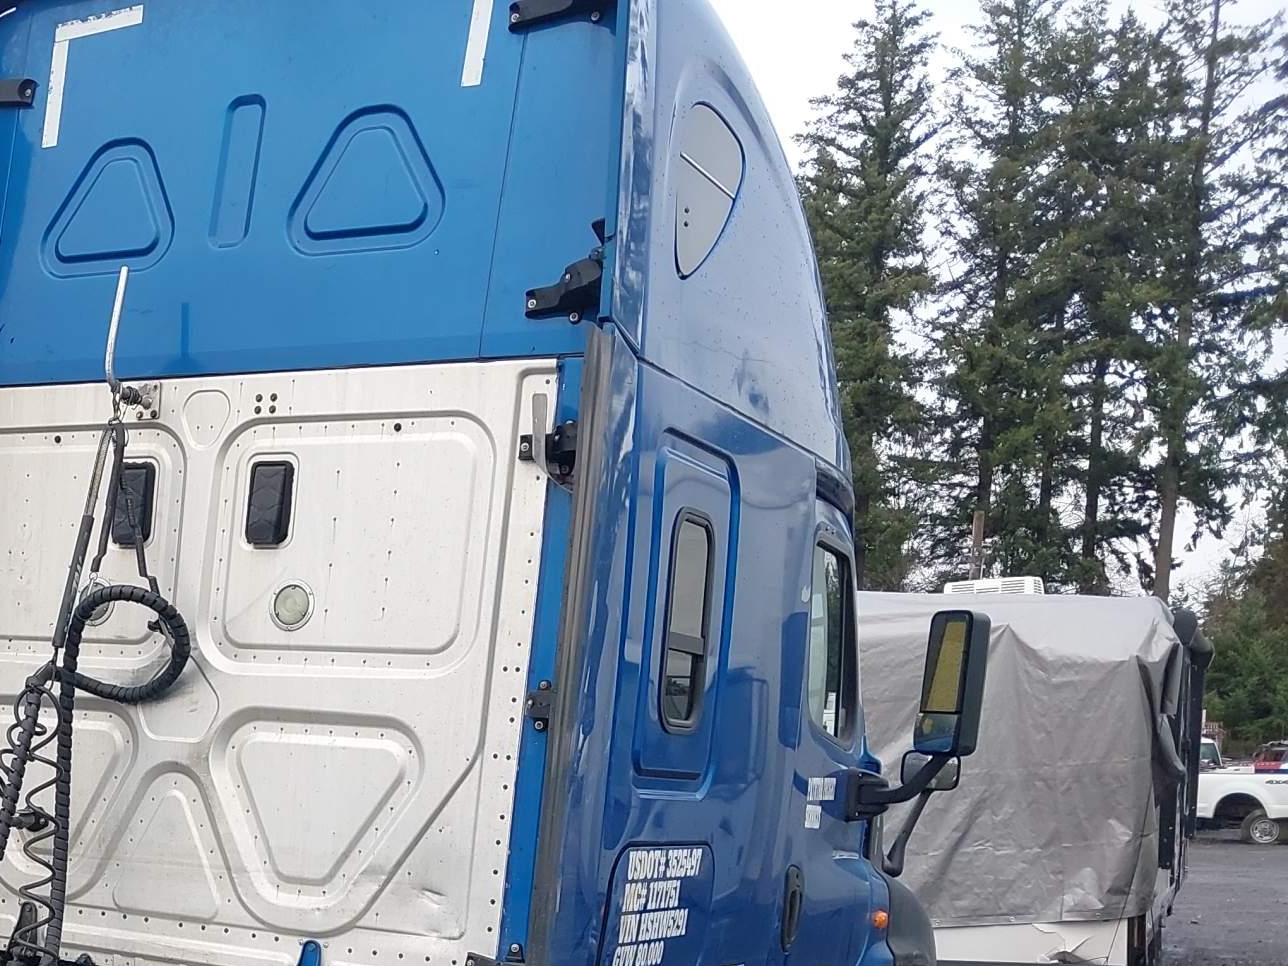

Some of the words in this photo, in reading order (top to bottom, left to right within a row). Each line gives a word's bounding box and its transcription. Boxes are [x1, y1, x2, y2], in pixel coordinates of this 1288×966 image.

[628, 850, 666, 880] USDOT#
[666, 848, 702, 878] 3525497
[622, 882, 648, 912] MC#
[618, 914, 640, 944] VIN
